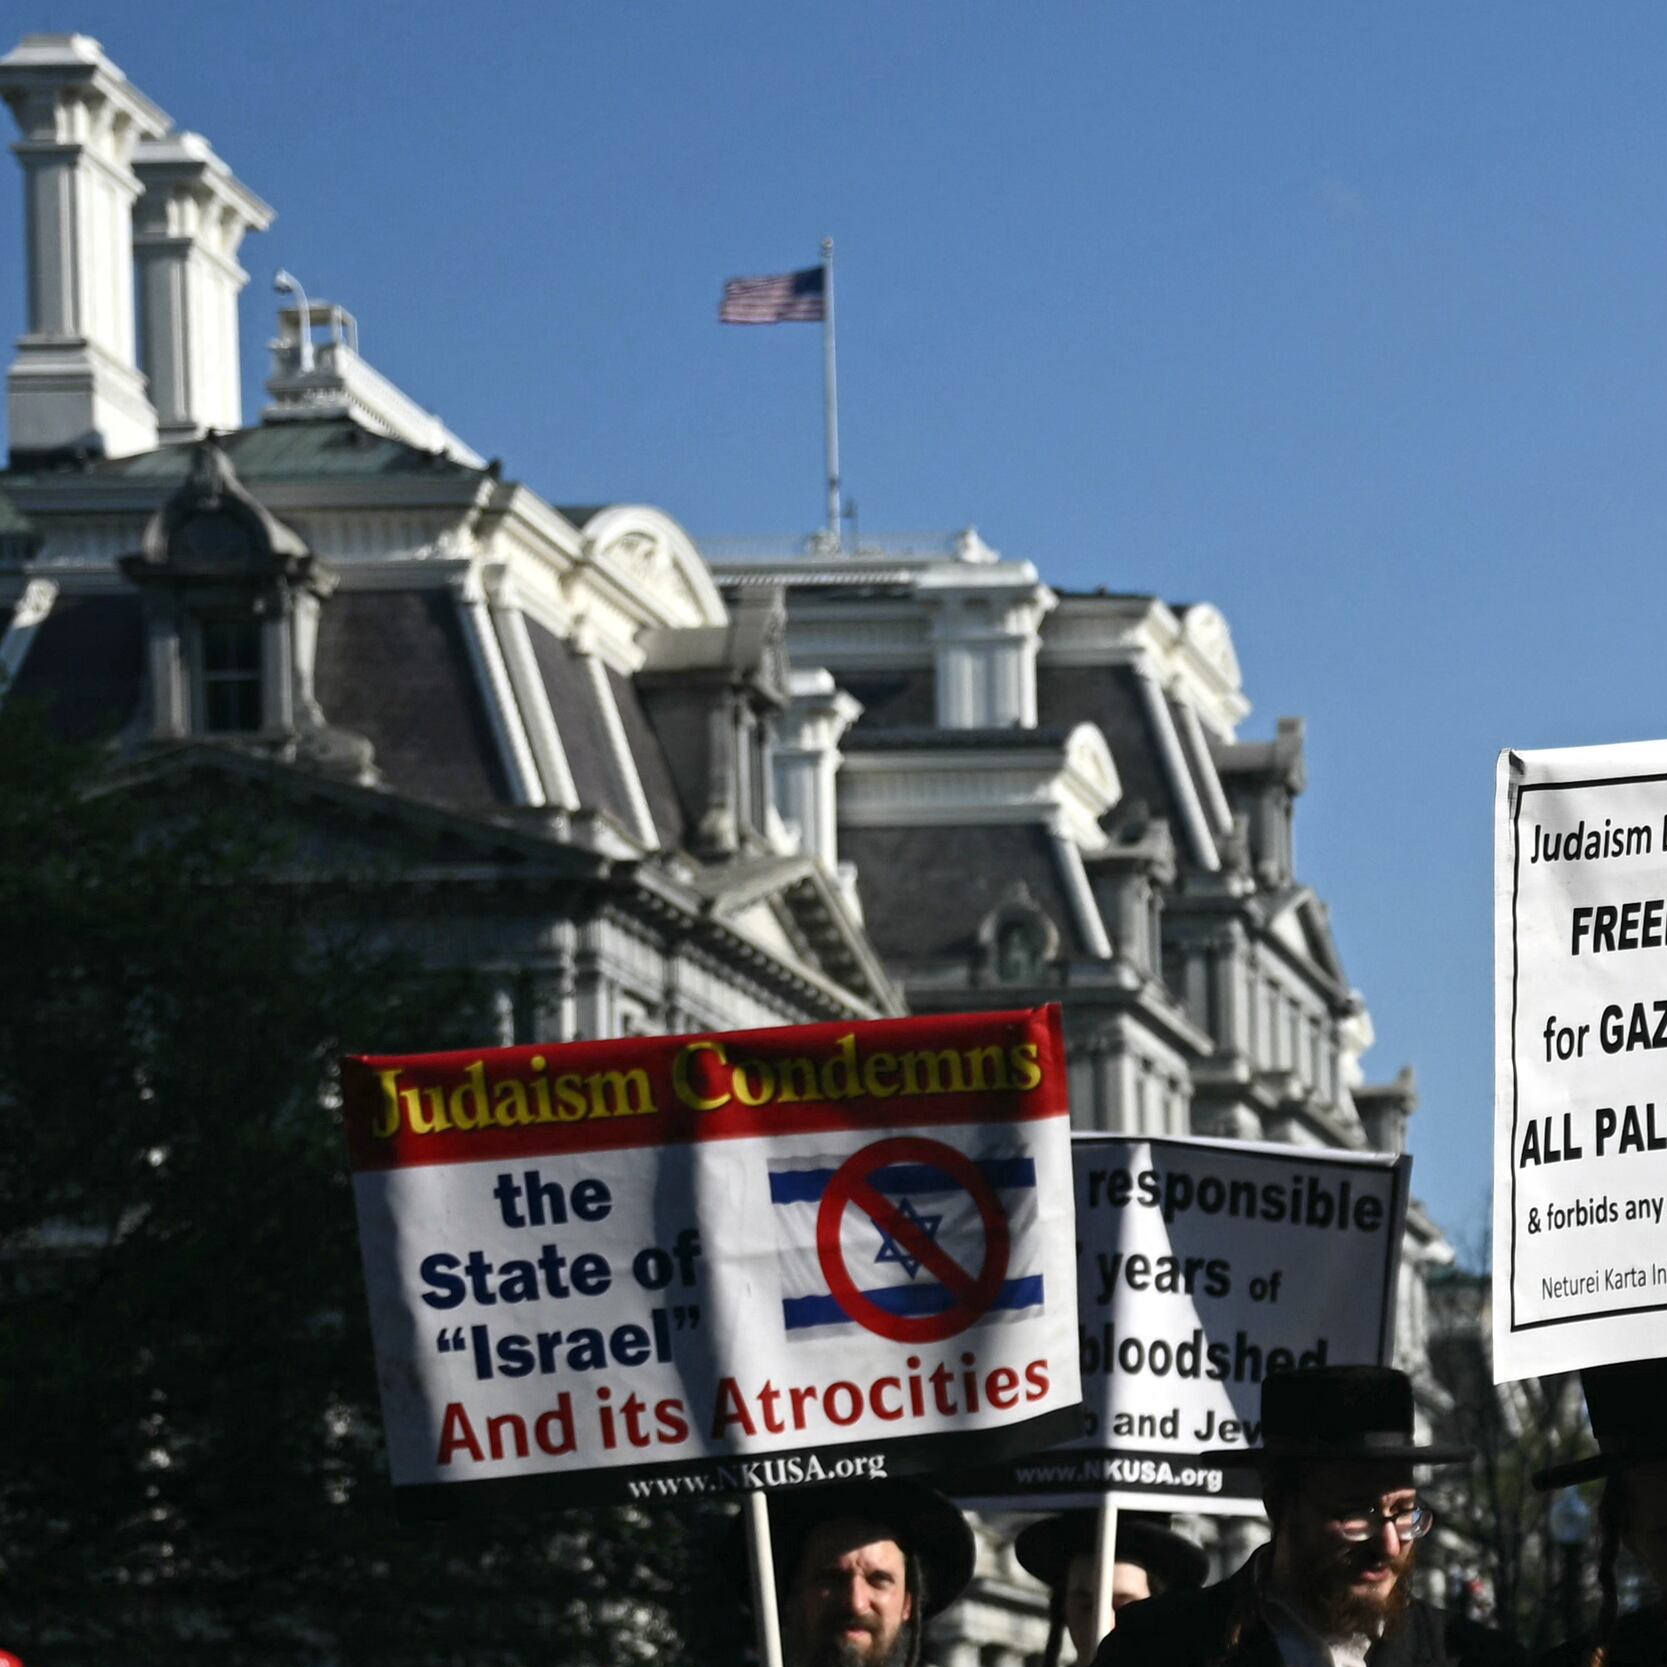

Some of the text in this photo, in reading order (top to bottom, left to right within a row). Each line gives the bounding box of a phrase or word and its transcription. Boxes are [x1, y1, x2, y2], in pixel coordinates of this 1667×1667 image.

[1529, 820, 1652, 865] Judaism
[1544, 1015, 1589, 1062] for
[372, 1033, 1042, 1141] Judaism Condemns
[1519, 1113, 1582, 1170] ALL
[494, 1170, 611, 1228] the
[1088, 1167, 1383, 1232] responsible
[1528, 1207, 1542, 1234] &
[1547, 1195, 1618, 1230] forbids
[1625, 1197, 1664, 1224] any
[420, 1228, 702, 1311] State of
[1097, 1251, 1231, 1305] years
[1249, 1270, 1281, 1302] of
[1542, 1270, 1600, 1300] Neturei
[1605, 1268, 1646, 1290] Karta
[436, 1306, 702, 1380] "Israel"
[1079, 1325, 1328, 1384] bloodshed
[438, 1355, 1050, 1464] And its Atrocities
[1114, 1408, 1179, 1439] and
[627, 1454, 888, 1499] www.NKUSA.org
[1014, 1459, 1224, 1493] www.NKUSA.org
